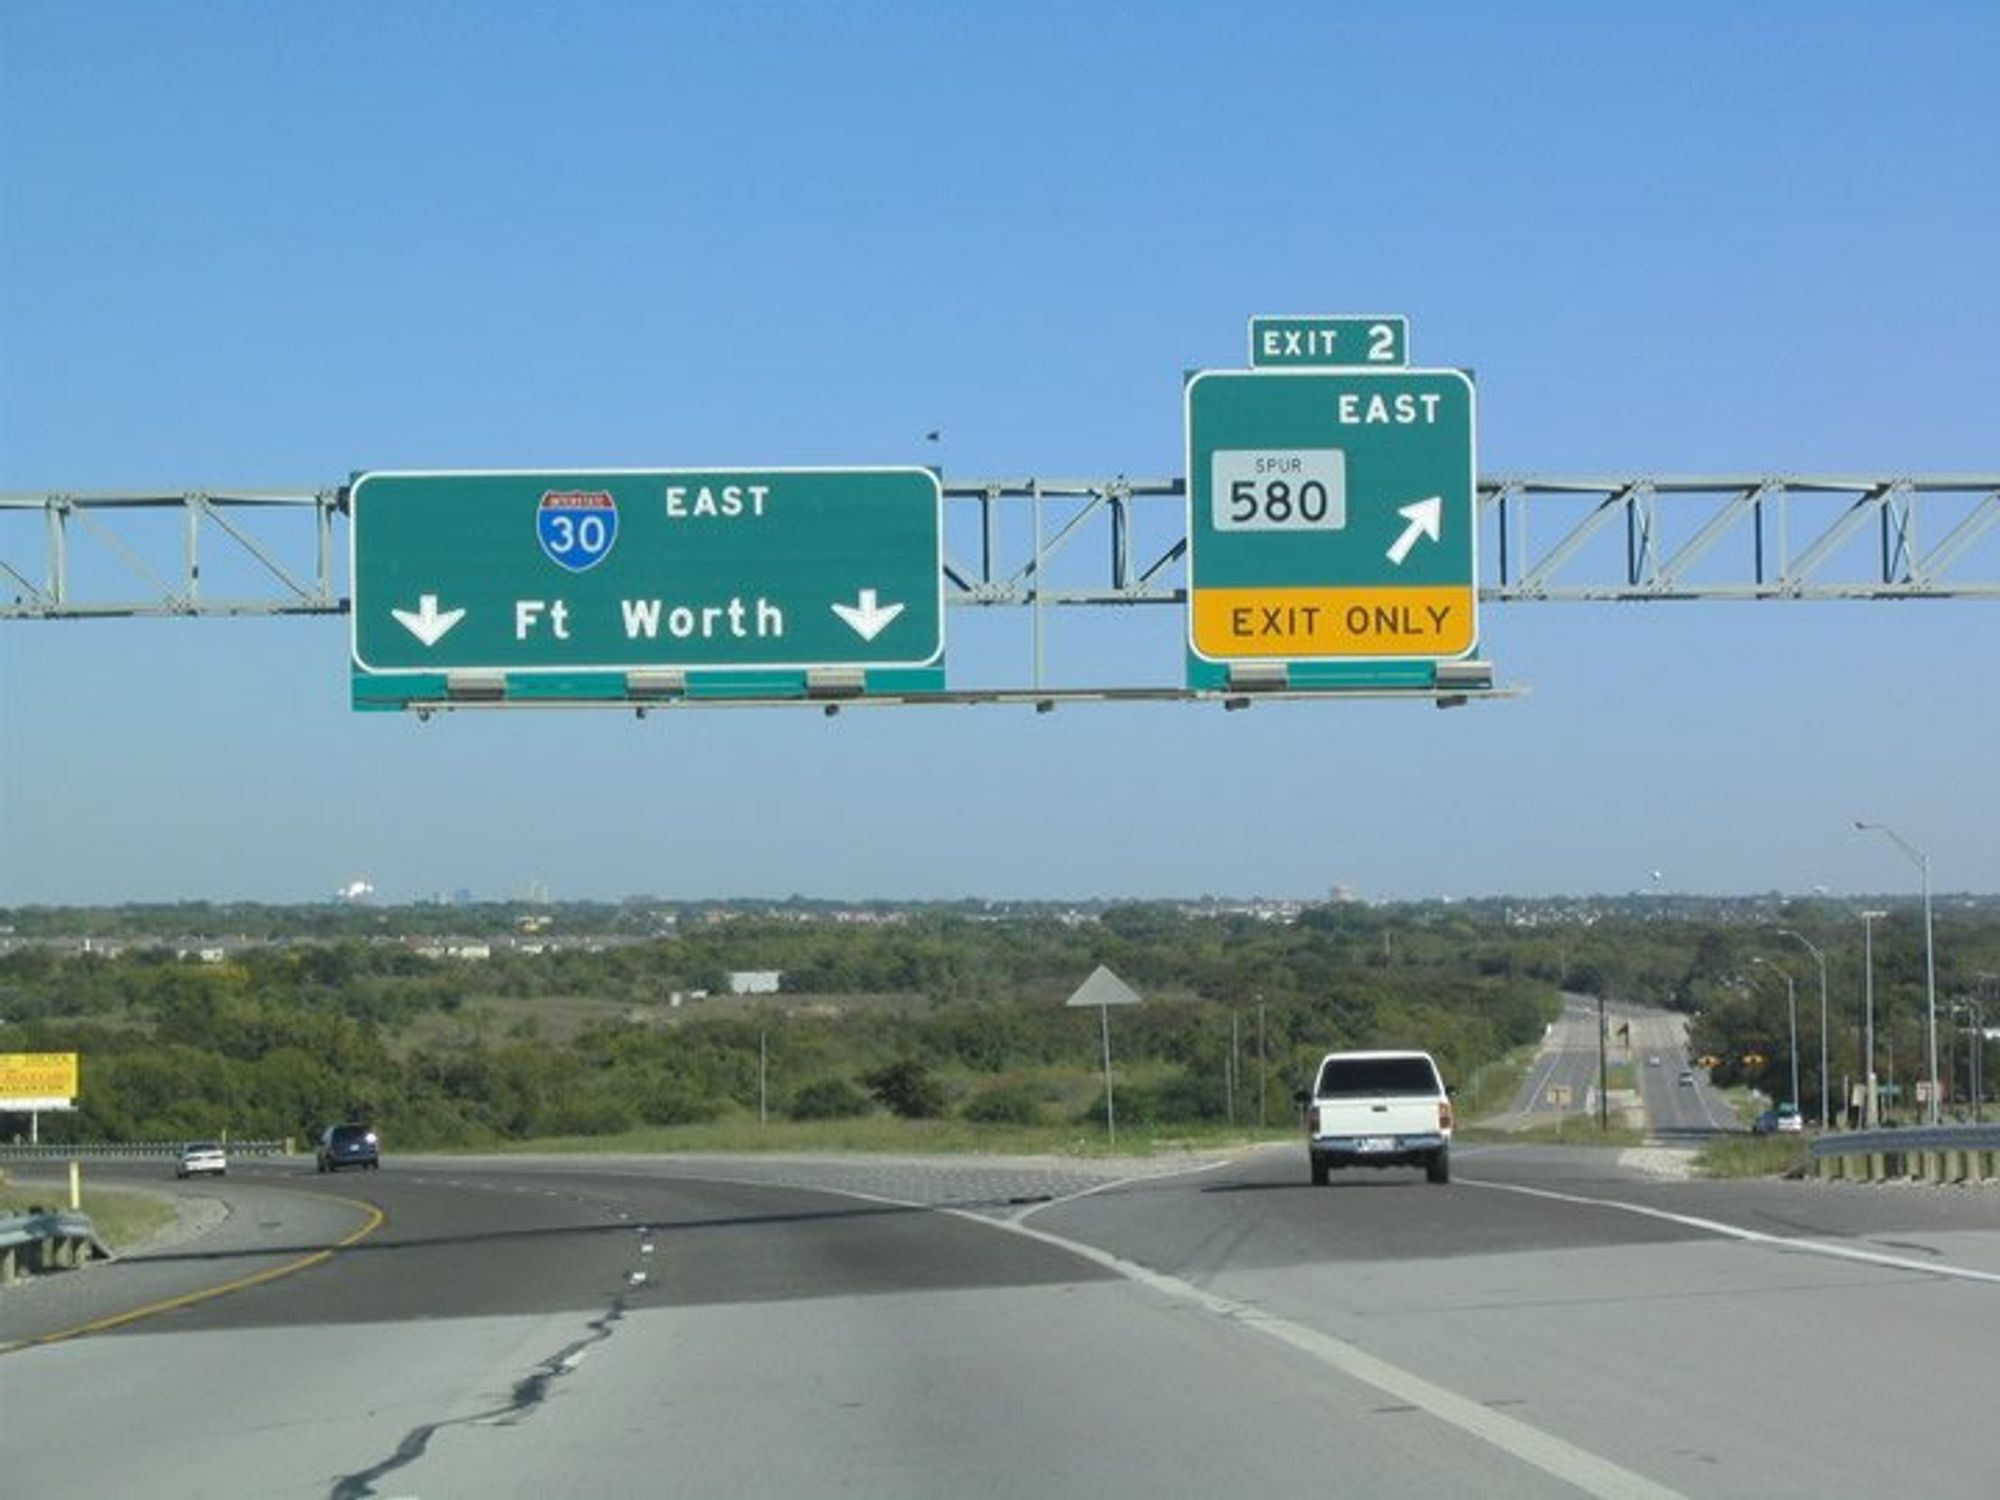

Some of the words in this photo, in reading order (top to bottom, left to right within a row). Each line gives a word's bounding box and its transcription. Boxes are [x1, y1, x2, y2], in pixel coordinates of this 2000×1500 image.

[1263, 331, 1338, 355] EXIT
[1368, 325, 1395, 360] 2
[1338, 395, 1441, 424] EAST
[1256, 459, 1302, 474] SPUR
[667, 487, 769, 516] EAST
[1231, 480, 1328, 522] 580
[551, 516, 605, 553] 30
[516, 601, 570, 639] Ft
[622, 599, 783, 638] Worth
[1232, 608, 1321, 637] EXIT
[1347, 606, 1451, 635] ONLY
